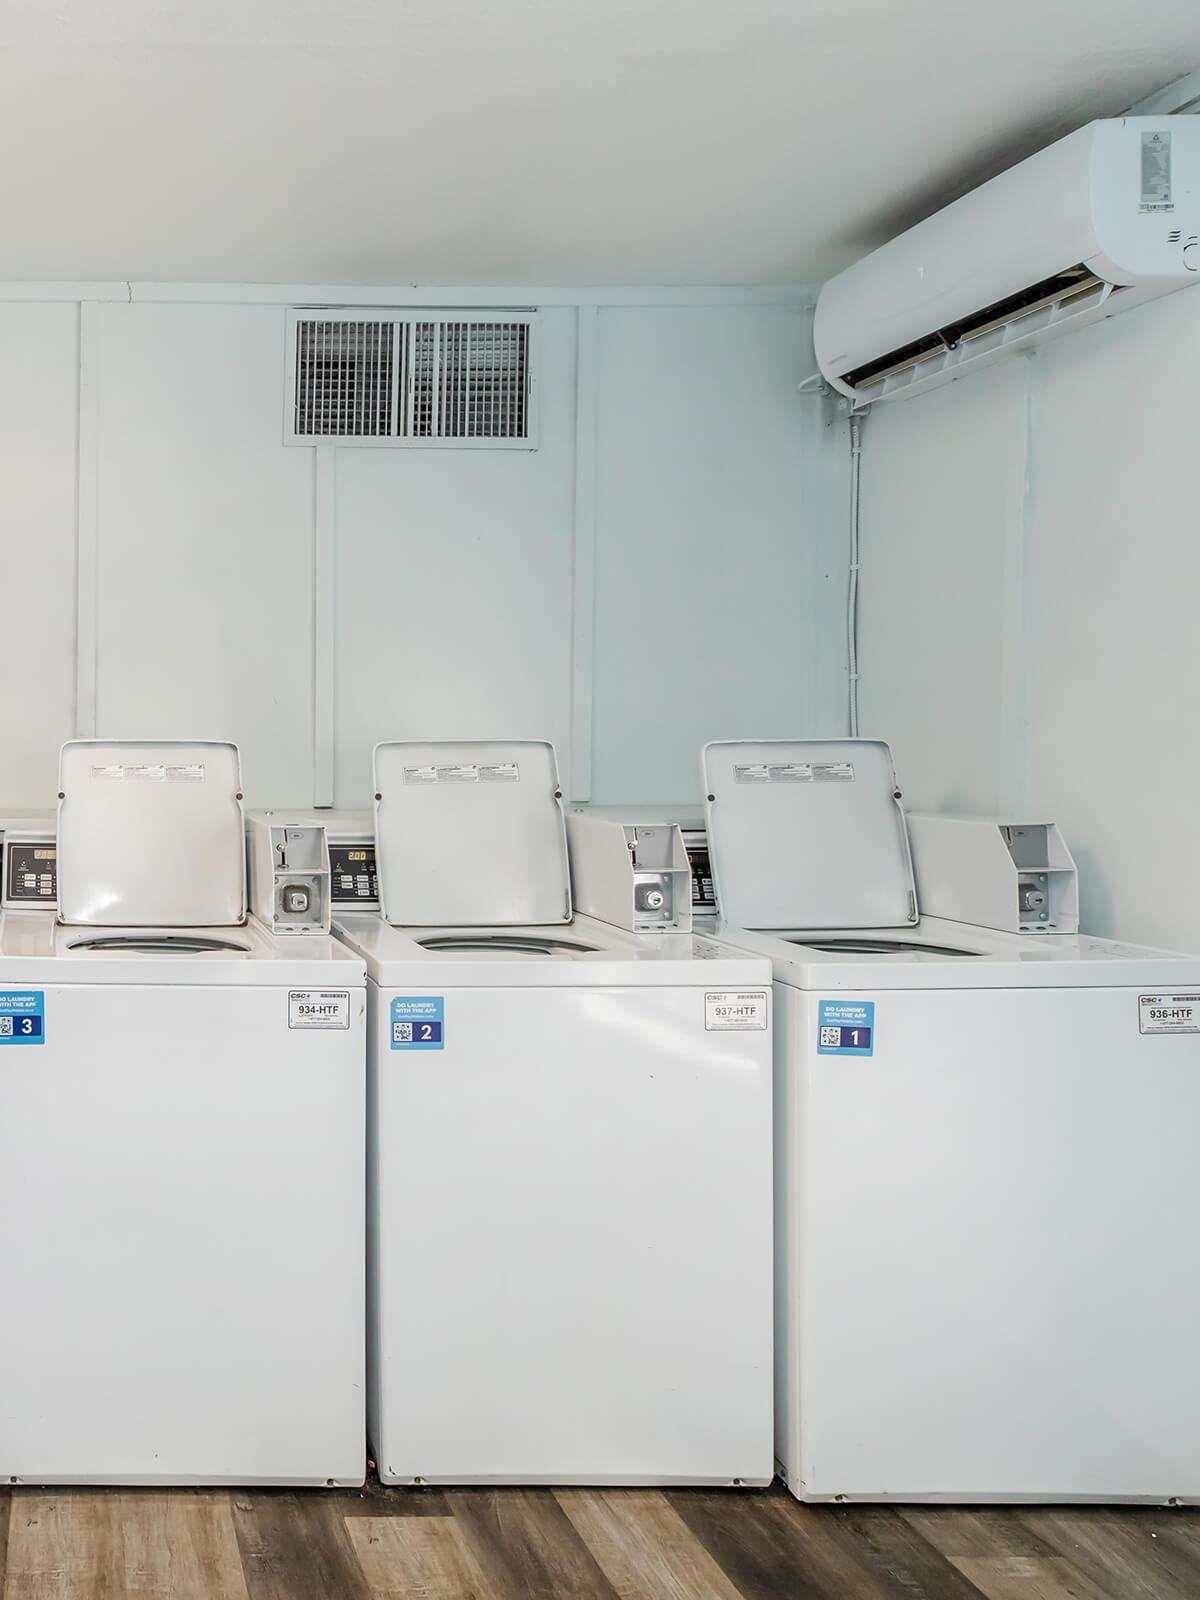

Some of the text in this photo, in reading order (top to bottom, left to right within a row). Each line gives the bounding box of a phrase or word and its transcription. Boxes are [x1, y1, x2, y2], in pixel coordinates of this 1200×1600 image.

[298, 1006, 339, 1014] 934-HTF
[715, 1007, 757, 1015] 937-HTF
[1150, 1009, 1193, 1018] 936-HTF
[21, 1018, 33, 1034] 3
[421, 1024, 432, 1040] 2
[851, 1030, 859, 1045] 1
